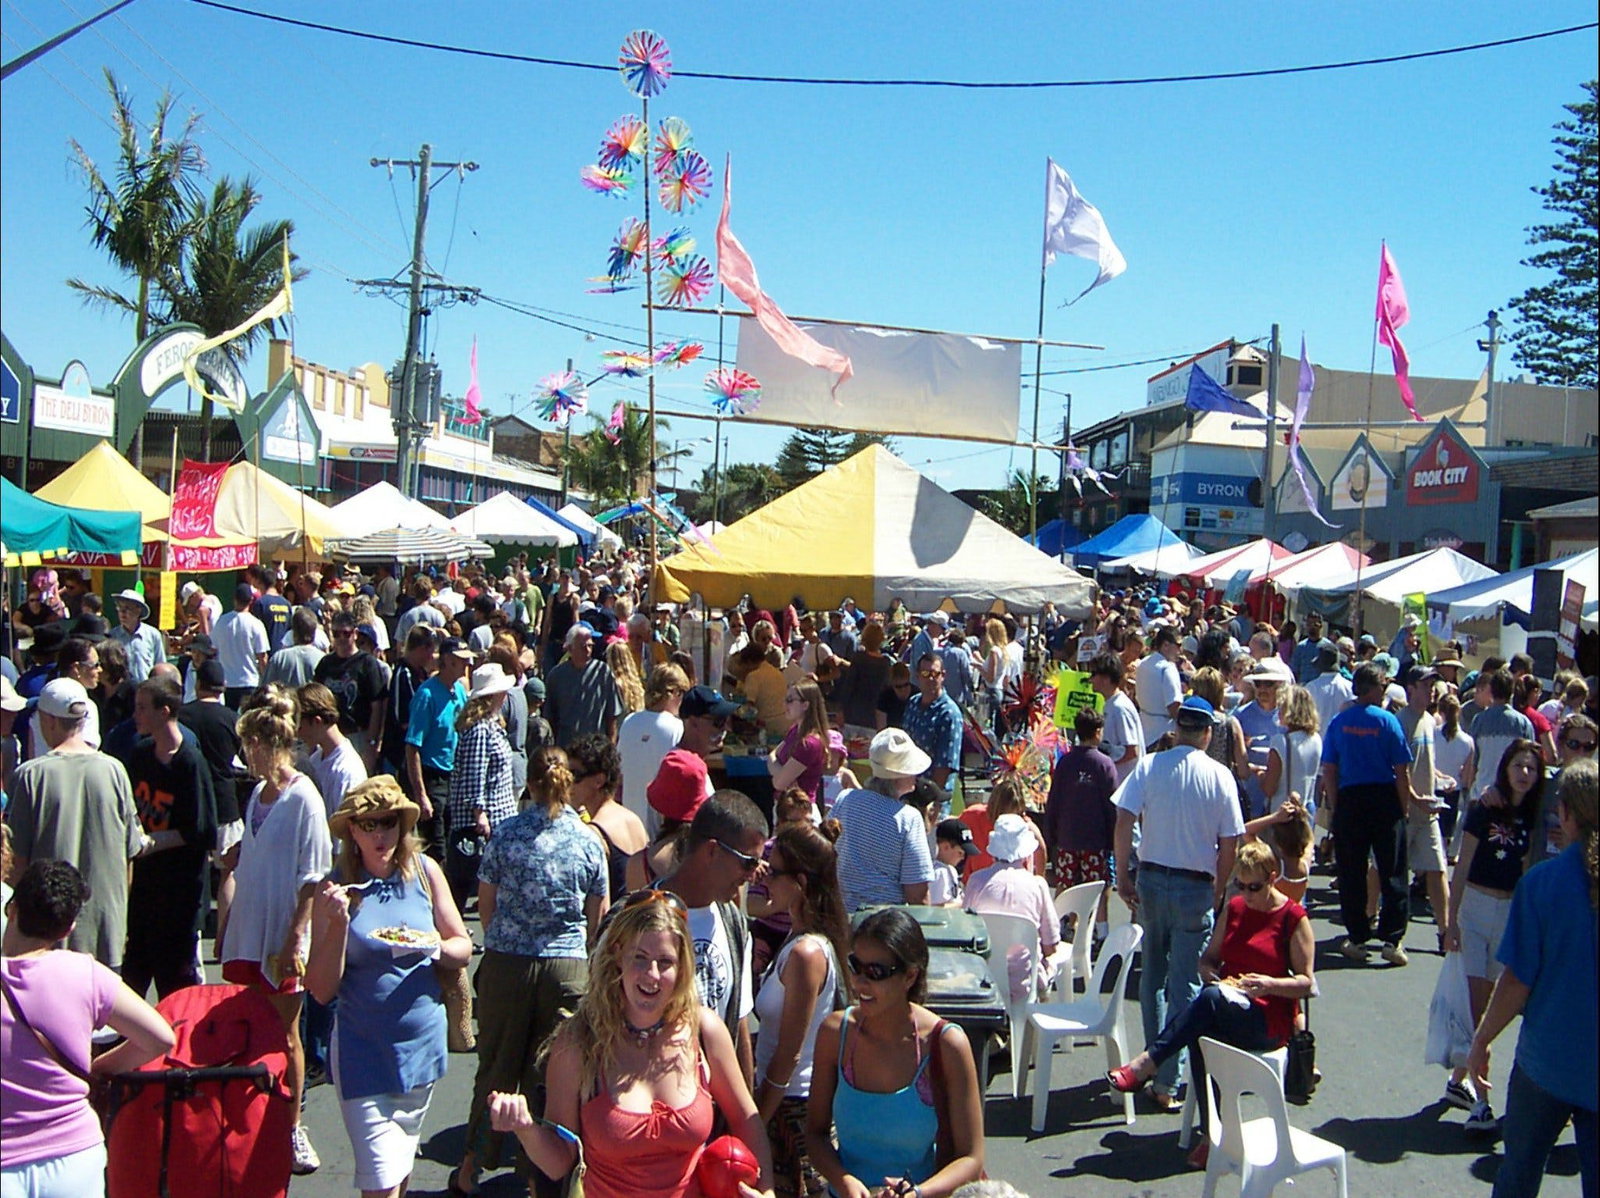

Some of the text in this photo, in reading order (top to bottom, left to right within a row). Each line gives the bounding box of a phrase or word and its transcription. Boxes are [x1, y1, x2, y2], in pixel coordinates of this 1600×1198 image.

[40, 396, 110, 425] THE DELI BYRON
[1413, 466, 1468, 488] BOOK CITY
[1197, 482, 1245, 497] BYRON
